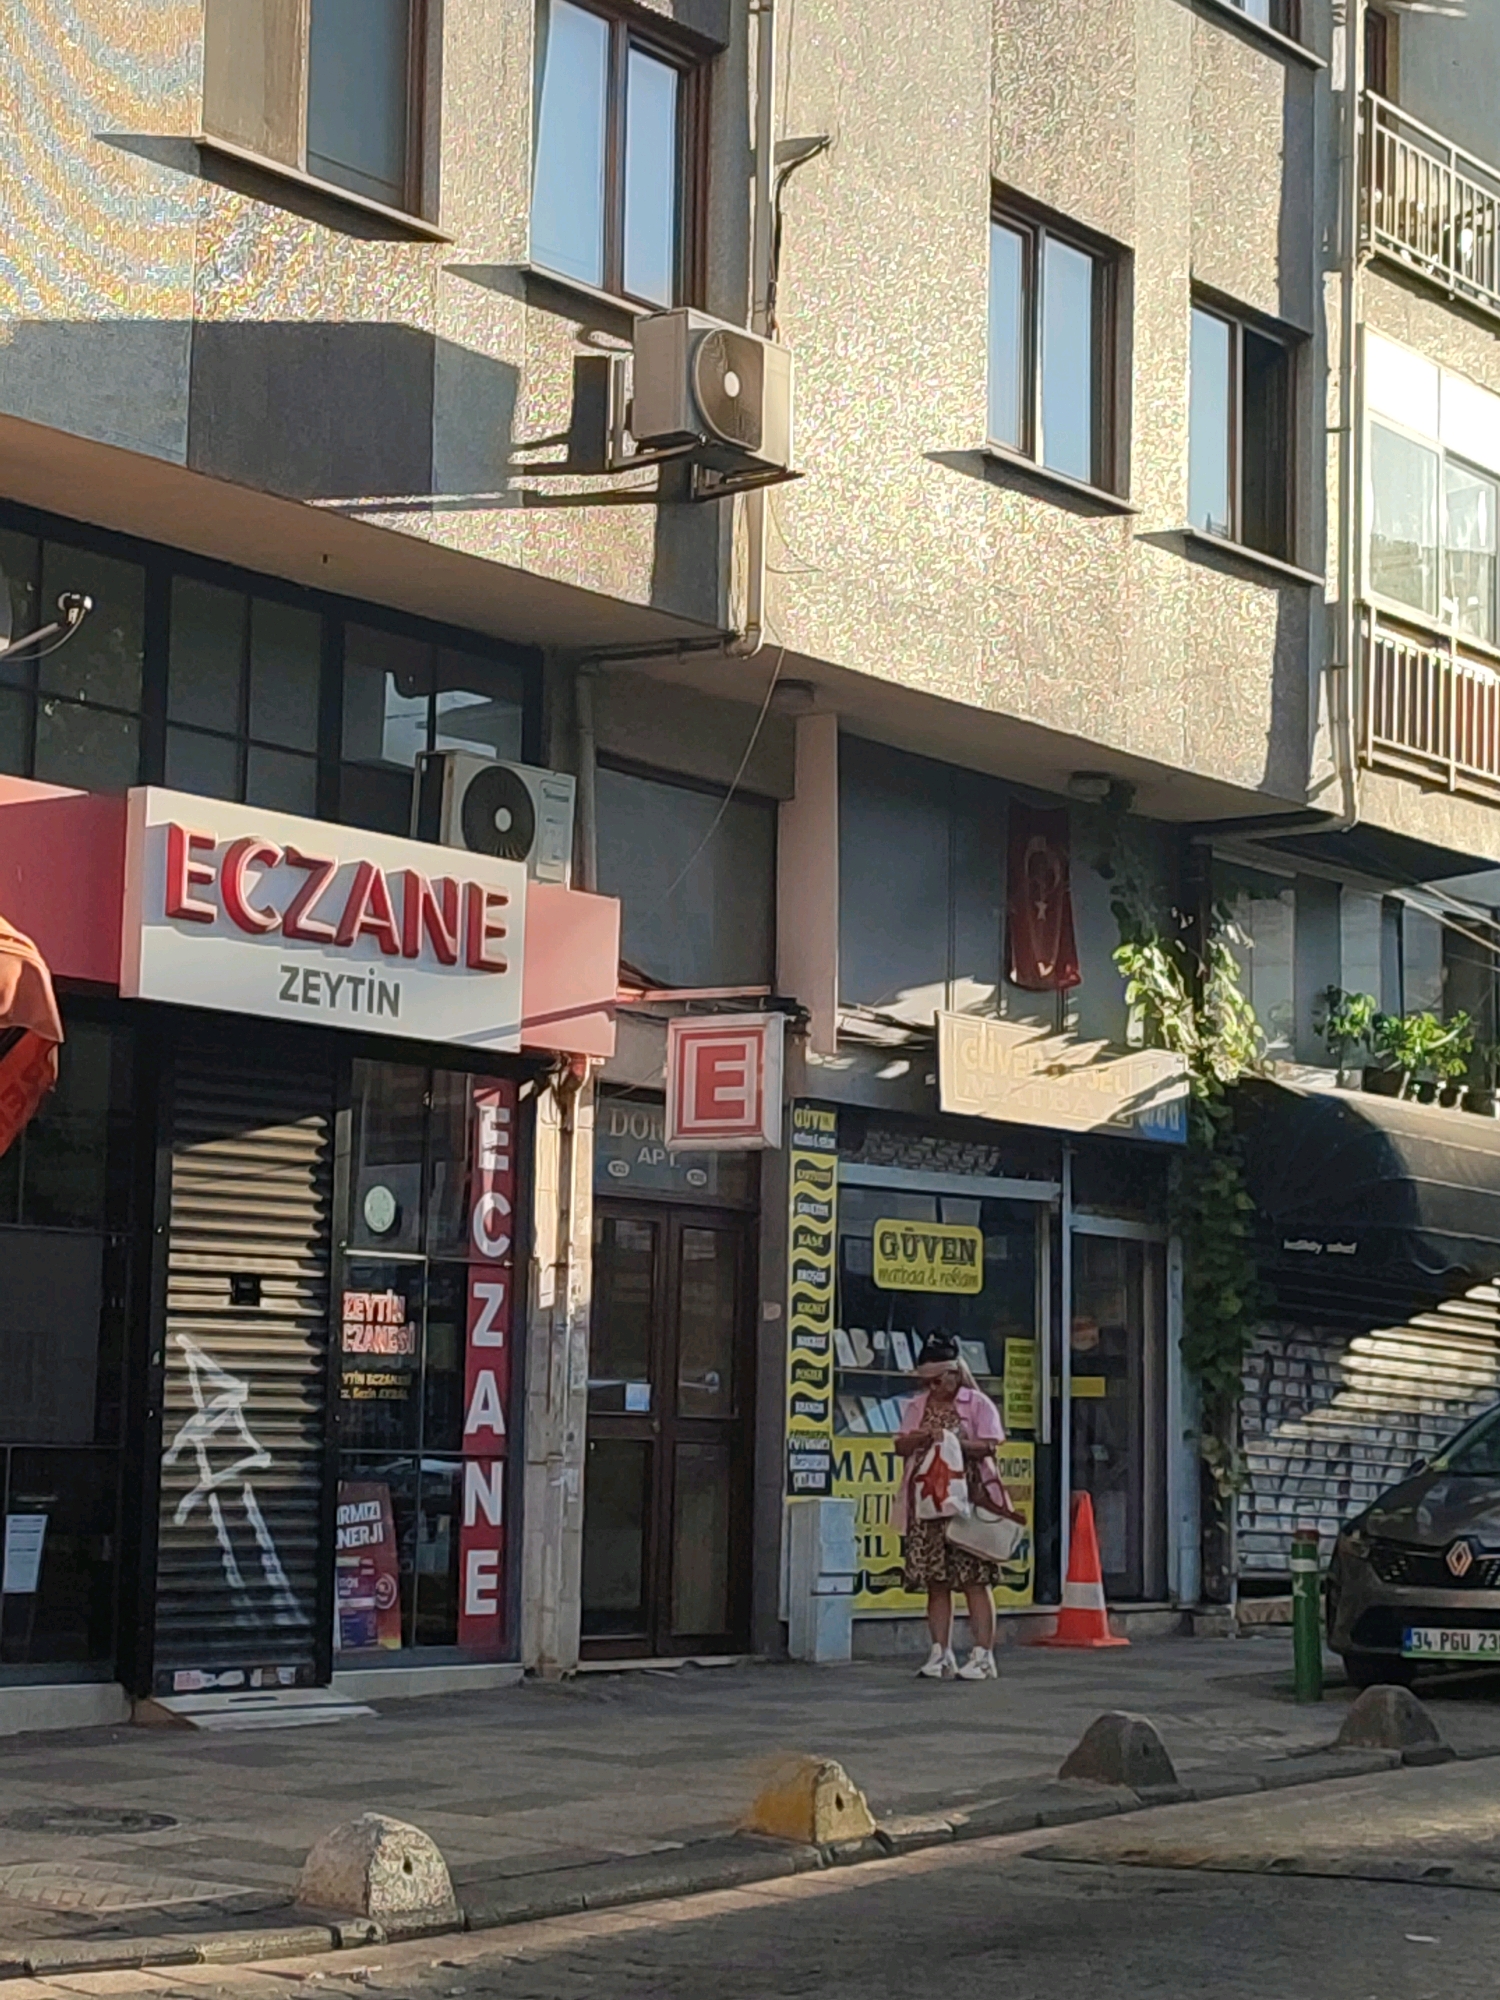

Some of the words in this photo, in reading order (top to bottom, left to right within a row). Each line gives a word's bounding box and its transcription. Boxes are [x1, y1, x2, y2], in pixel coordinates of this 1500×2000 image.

[165, 822, 510, 974] ECZANE
[279, 964, 400, 1019] ZEYTİN
[694, 1044, 747, 1121] E
[879, 1226, 977, 1268] GÜVEN
[342, 1288, 406, 1324] ZEYTİN
[463, 1106, 512, 1616] ECZANE
[1412, 1631, 1433, 1650] 34
[1440, 1631, 1471, 1651] PGU
[1477, 1633, 1500, 1653] 23
